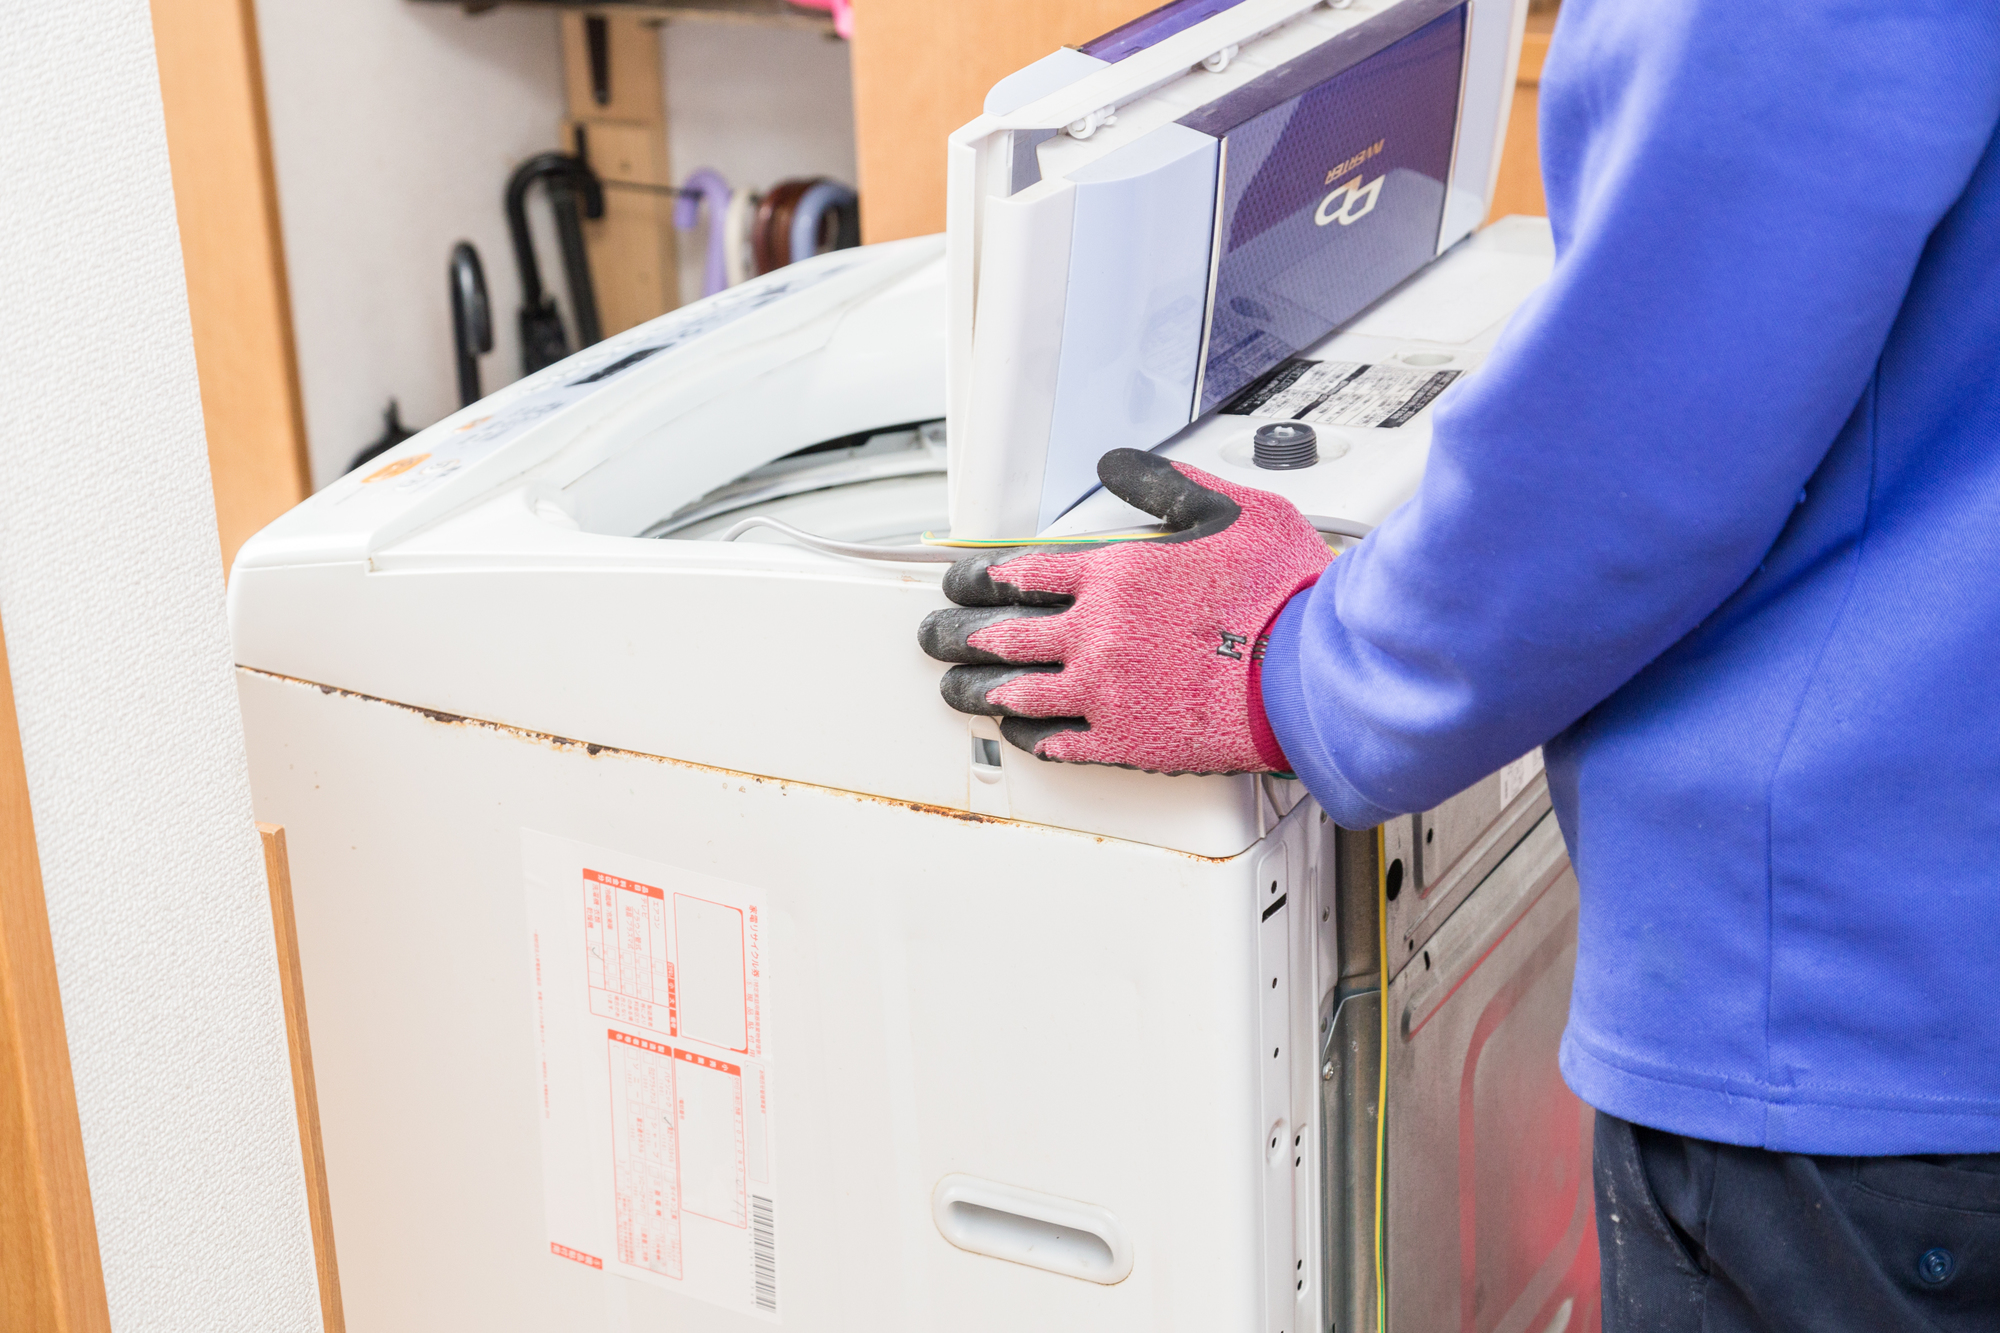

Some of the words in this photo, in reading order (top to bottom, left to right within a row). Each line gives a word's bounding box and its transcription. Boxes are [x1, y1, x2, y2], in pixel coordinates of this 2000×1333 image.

[749, 903, 759, 978] 家電リサイクル券
[651, 1121, 659, 1158] シャープ
